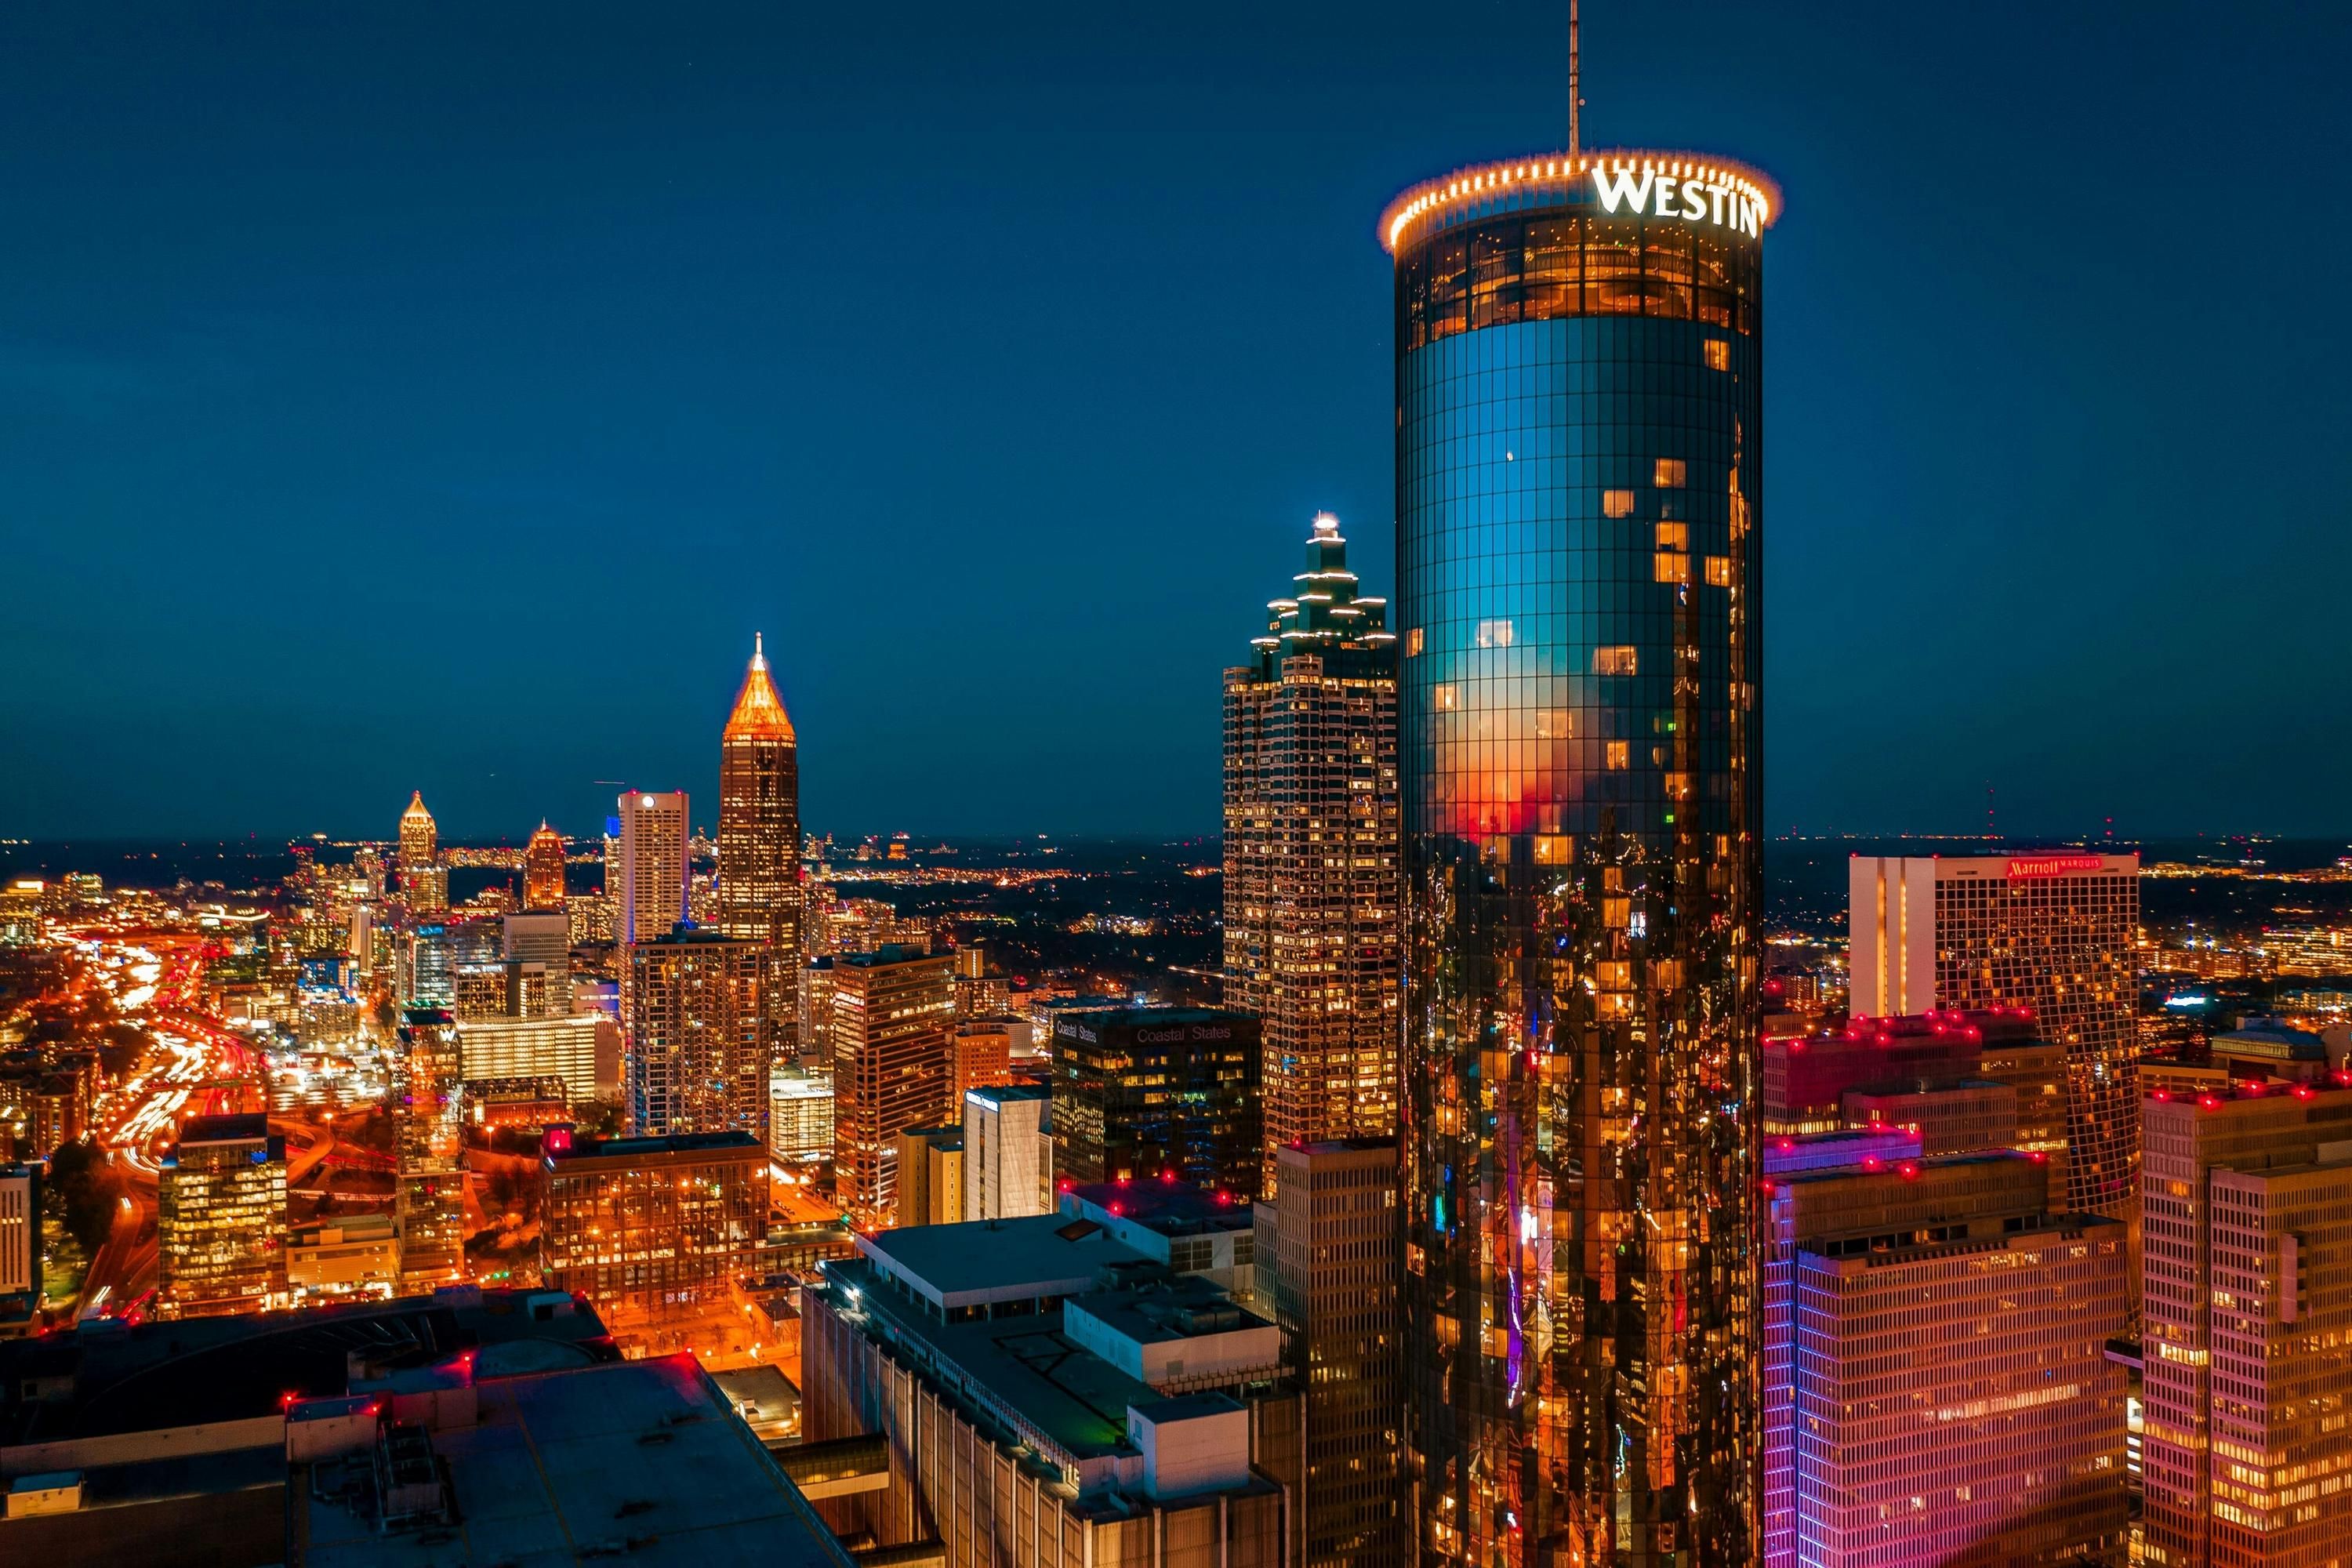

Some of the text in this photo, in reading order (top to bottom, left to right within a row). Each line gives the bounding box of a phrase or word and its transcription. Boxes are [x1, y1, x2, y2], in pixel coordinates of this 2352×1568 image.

[1592, 165, 1757, 238] WESTIN
[2008, 859, 2100, 877] Marriott MARQUIS
[439, 1029, 455, 1042] W
[1057, 1020, 1097, 1044] Coastal States
[1137, 1025, 1232, 1044] Coastal States
